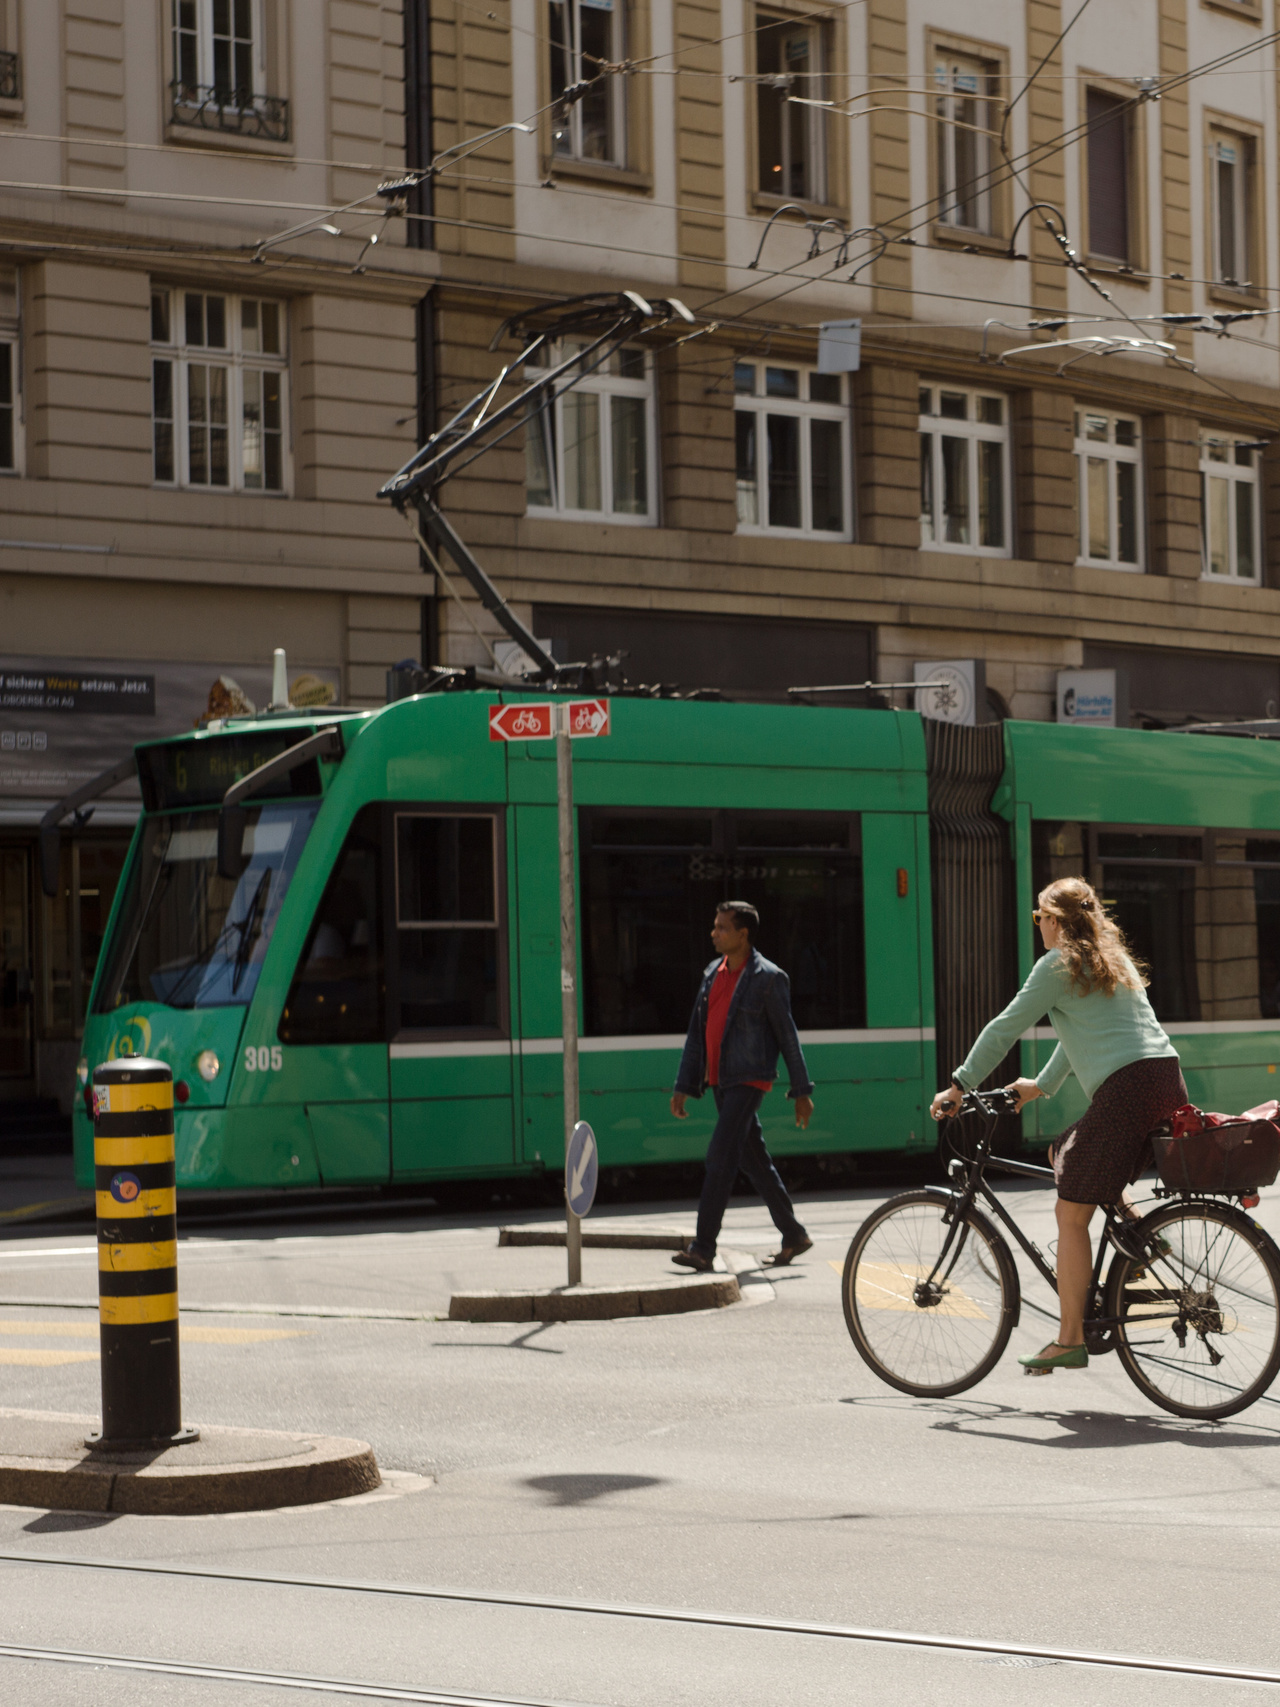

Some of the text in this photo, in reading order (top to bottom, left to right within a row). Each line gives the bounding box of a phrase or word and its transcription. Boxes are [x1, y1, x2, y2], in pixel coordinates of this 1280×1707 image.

[6, 674, 45, 690] sichere
[46, 677, 79, 691] Werte
[81, 679, 118, 693] setzen.
[121, 679, 150, 694] Jetzt.
[176, 750, 188, 793] 6
[245, 1046, 283, 1072] 305
